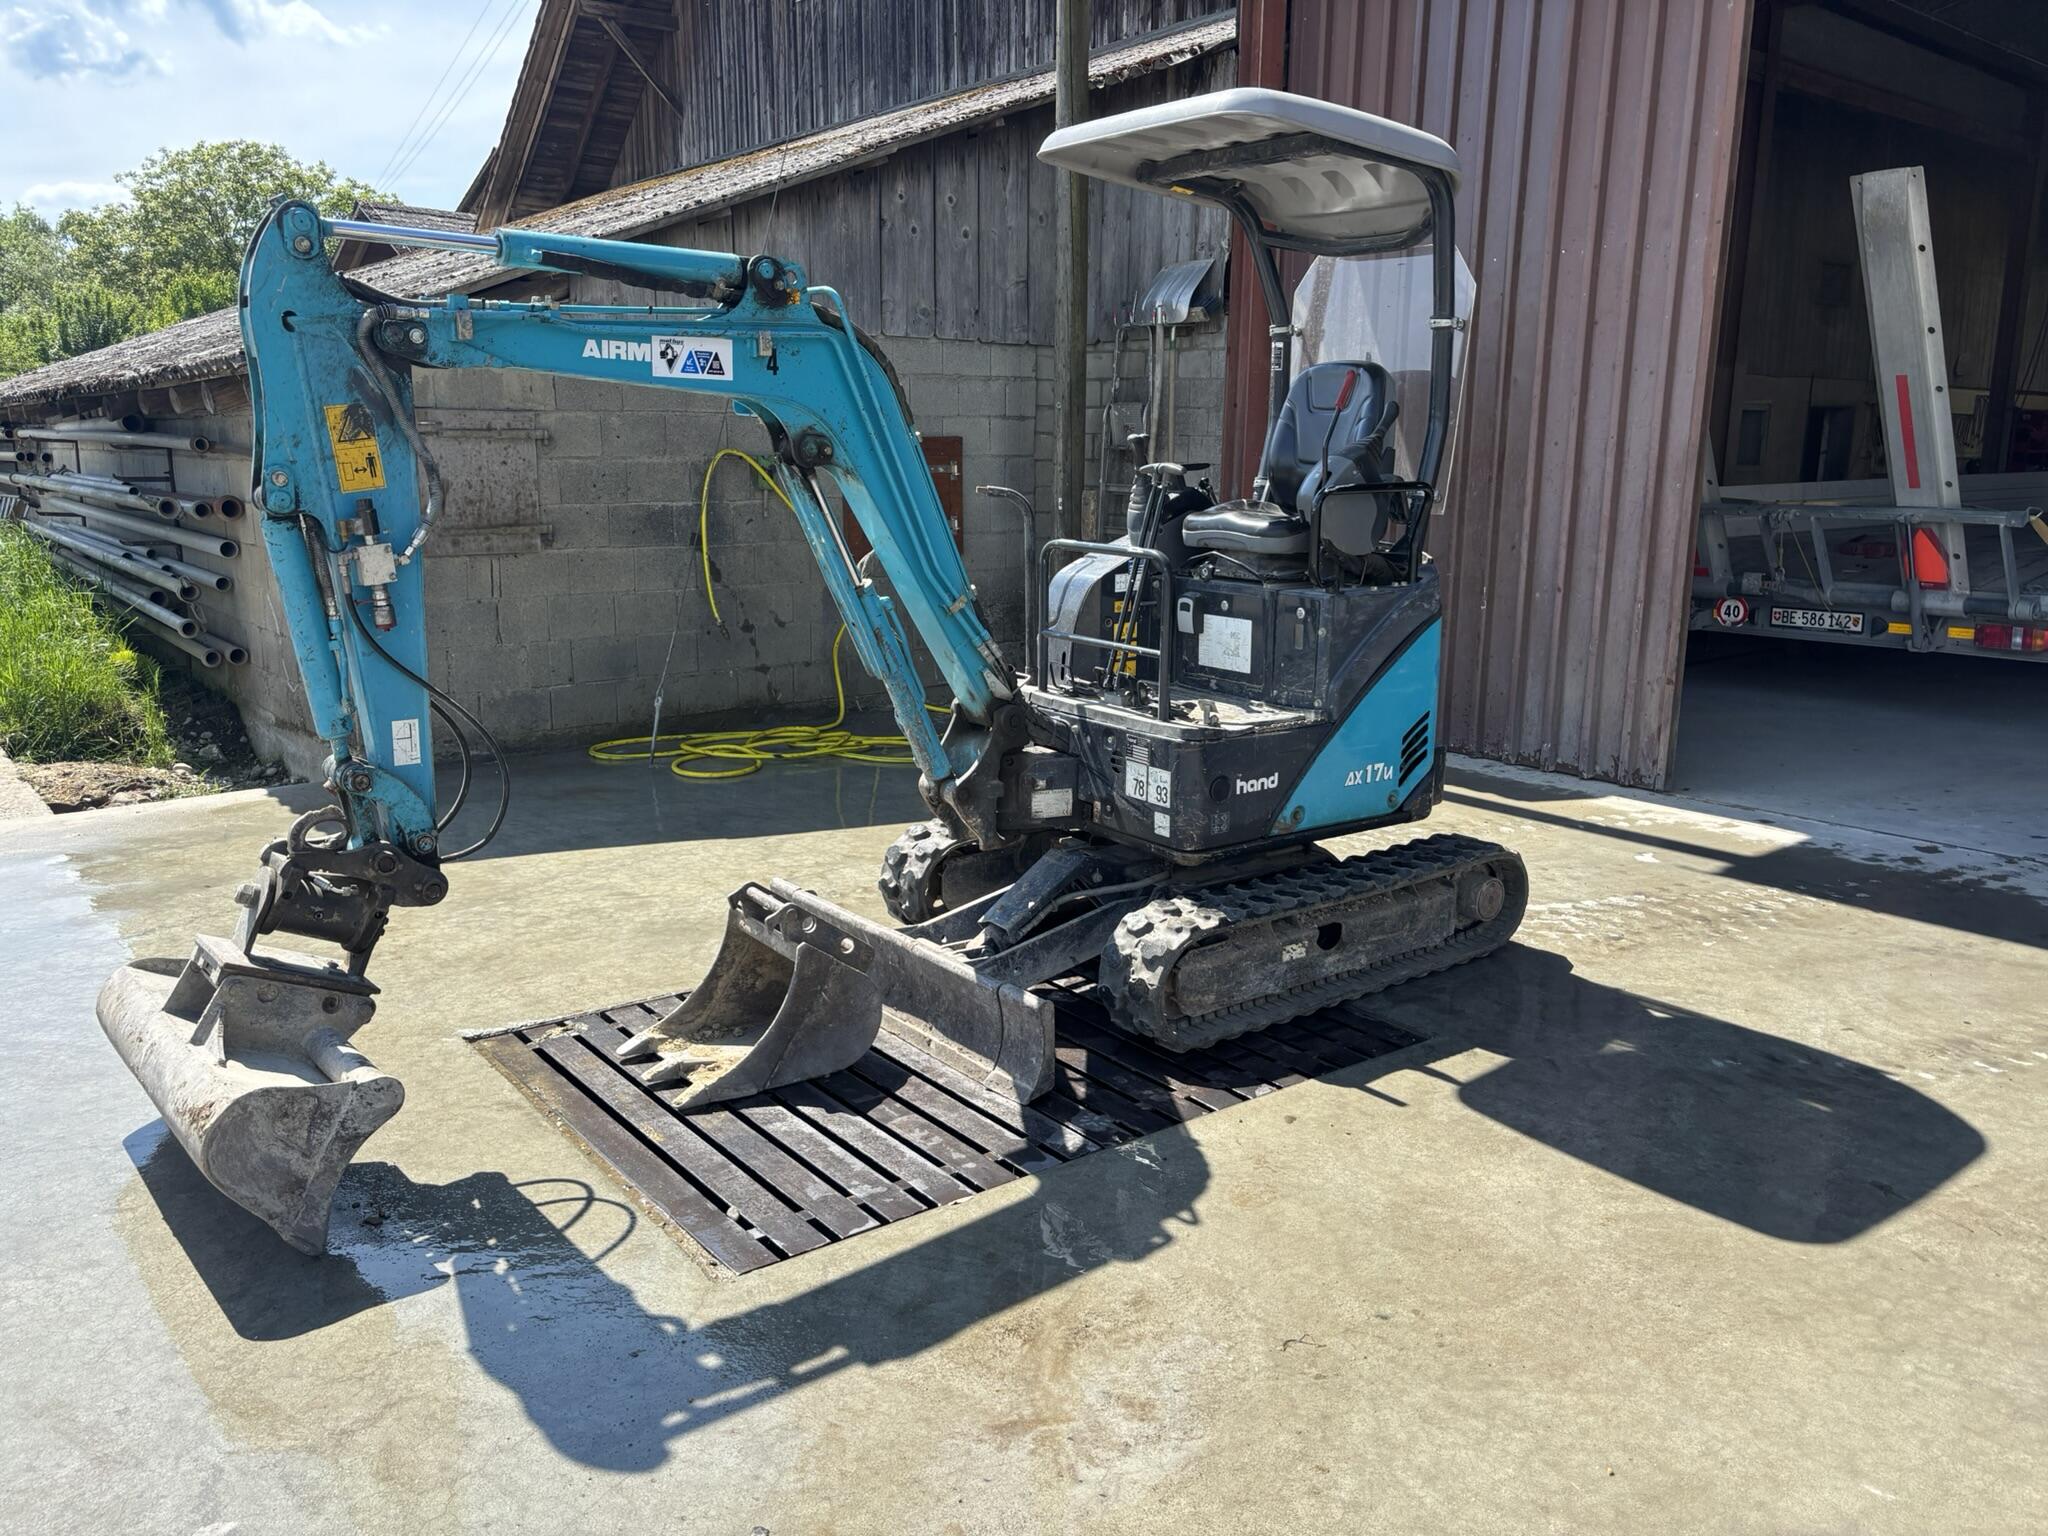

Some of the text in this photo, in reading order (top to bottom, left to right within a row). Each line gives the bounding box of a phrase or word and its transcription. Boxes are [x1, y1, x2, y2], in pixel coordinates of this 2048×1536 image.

[582, 339, 652, 362] AIRM
[767, 348, 780, 376] 4
[1724, 604, 1740, 618] 40
[1133, 778, 1145, 797] 78
[1236, 772, 1279, 795] hand
[1156, 785, 1168, 804] 93
